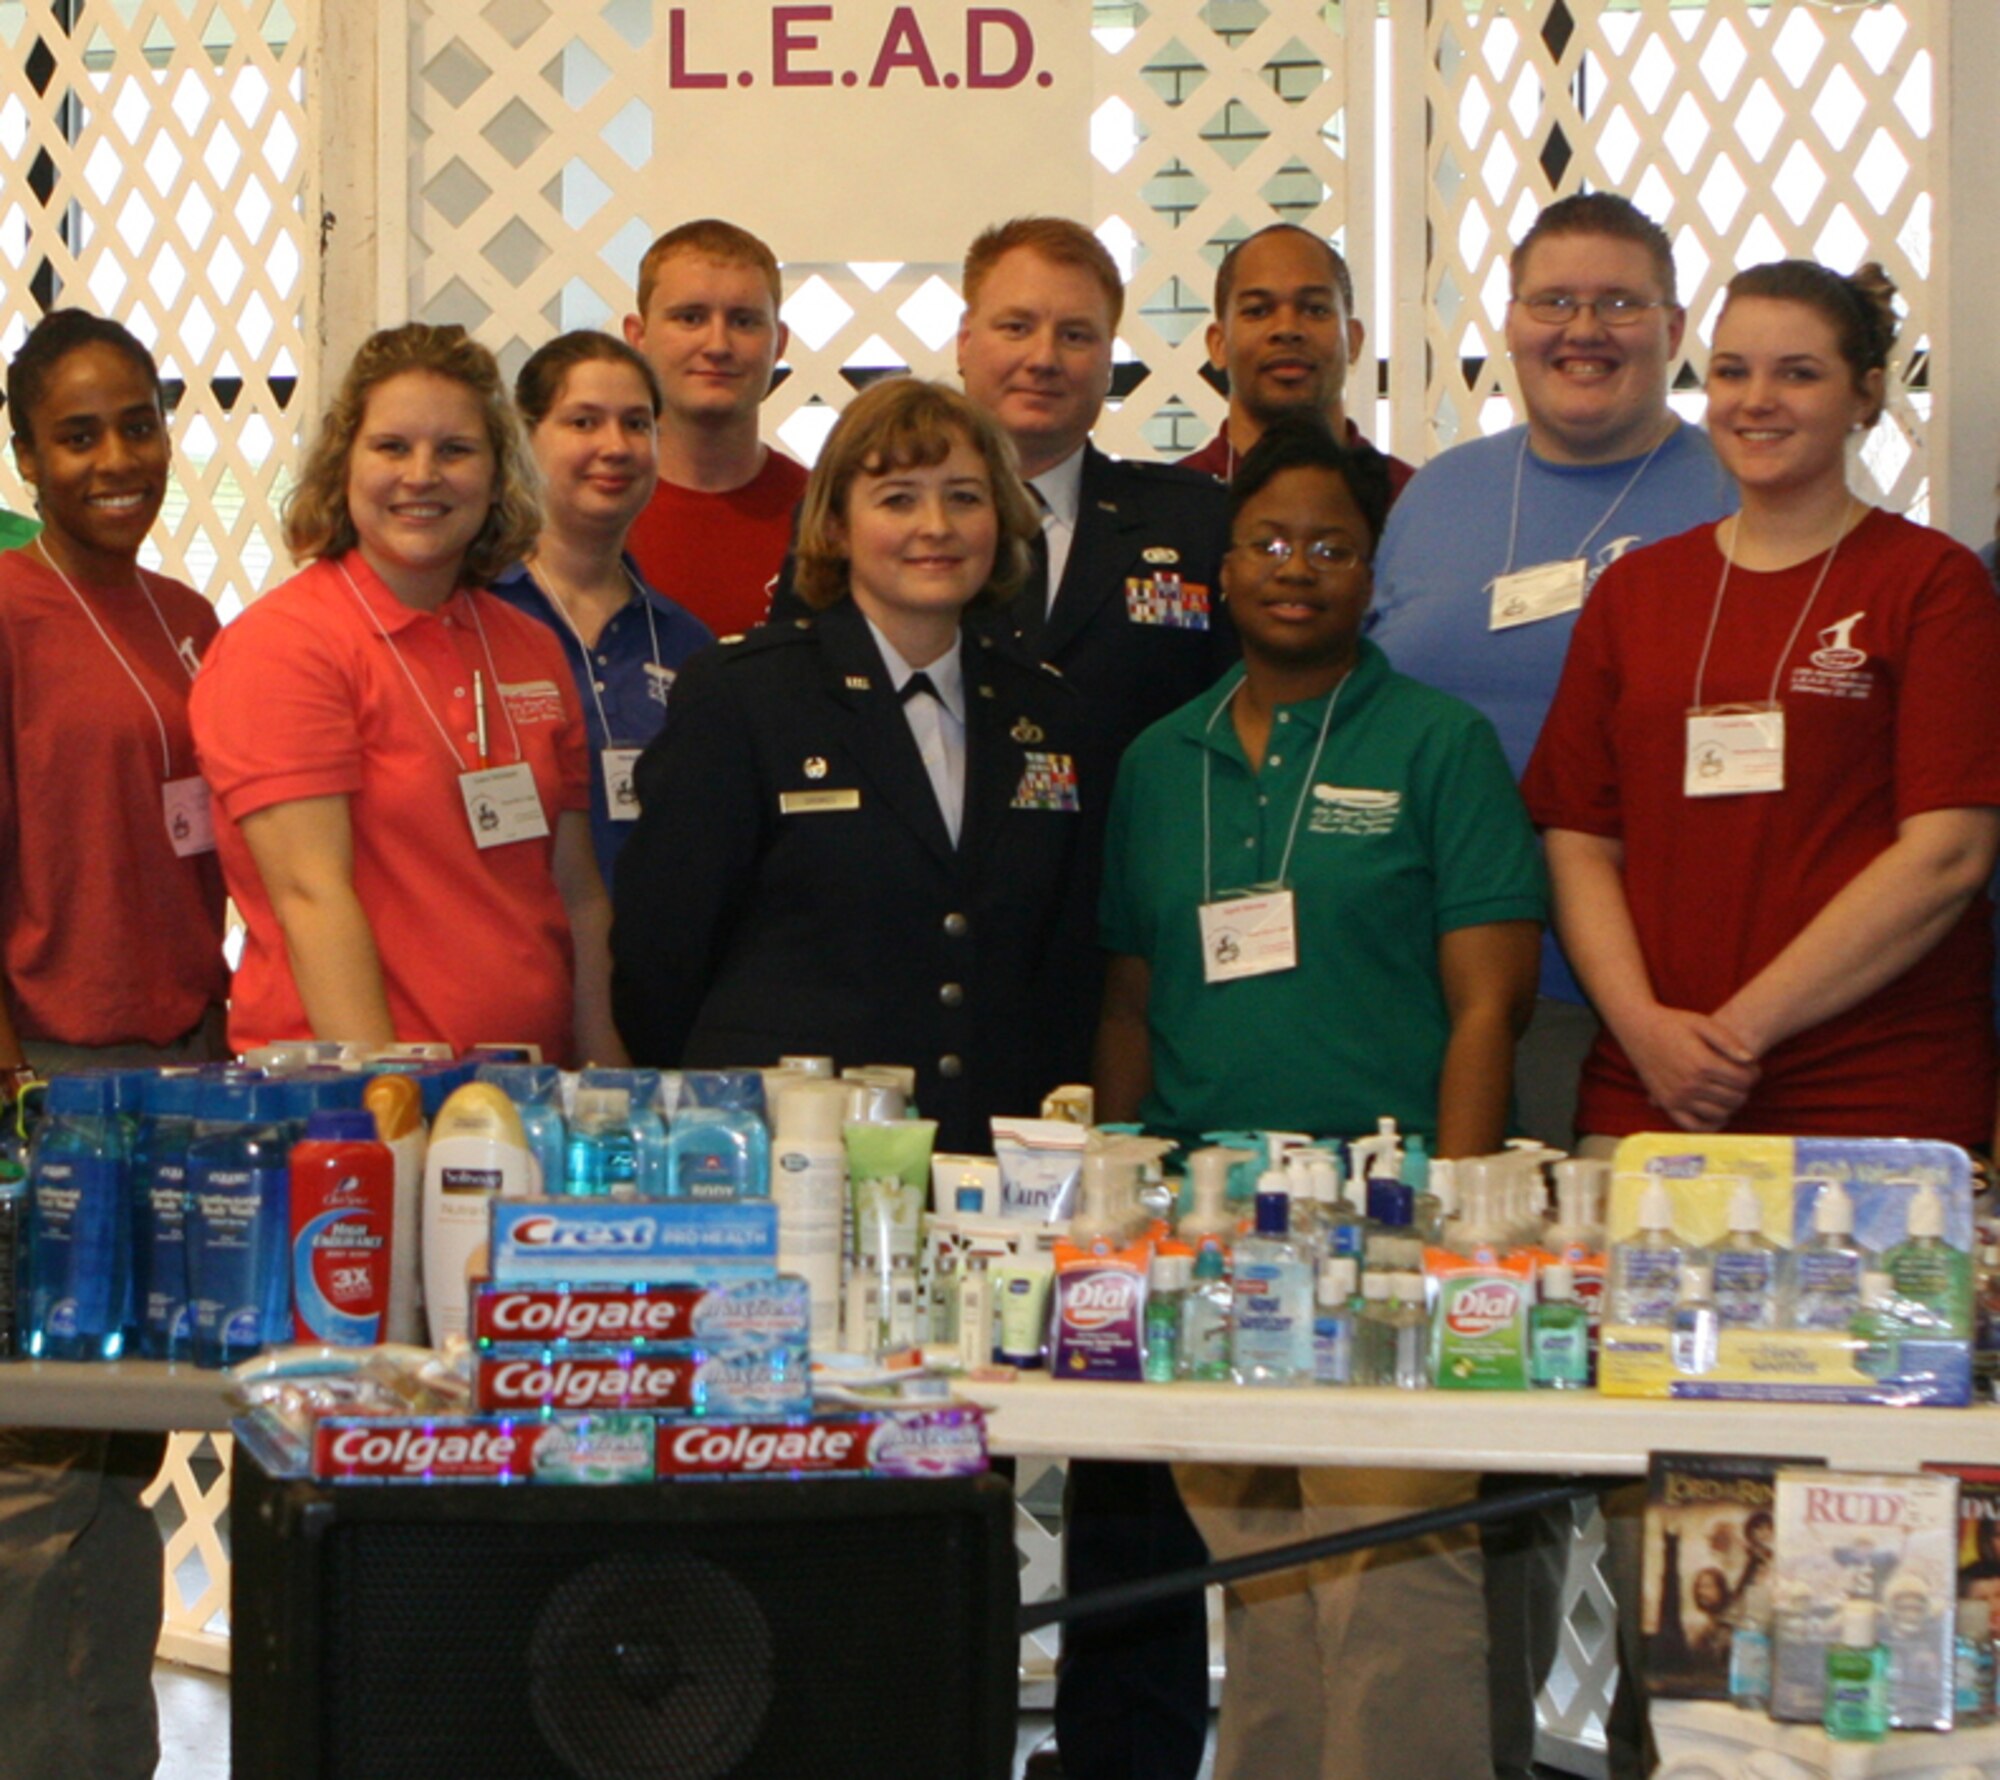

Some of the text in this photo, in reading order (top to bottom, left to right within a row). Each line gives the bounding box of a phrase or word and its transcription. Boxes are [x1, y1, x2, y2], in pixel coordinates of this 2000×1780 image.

[669, 5, 1053, 89] L.E.A.D.
[512, 1214, 656, 1246] Crest
[1069, 1282, 1131, 1309] Dial
[1451, 1289, 1515, 1316] Dial
[492, 1296, 677, 1338] Colgate
[493, 1363, 677, 1405] Colgate
[331, 1429, 517, 1473] Colgate
[672, 1427, 852, 1470] Colgate
